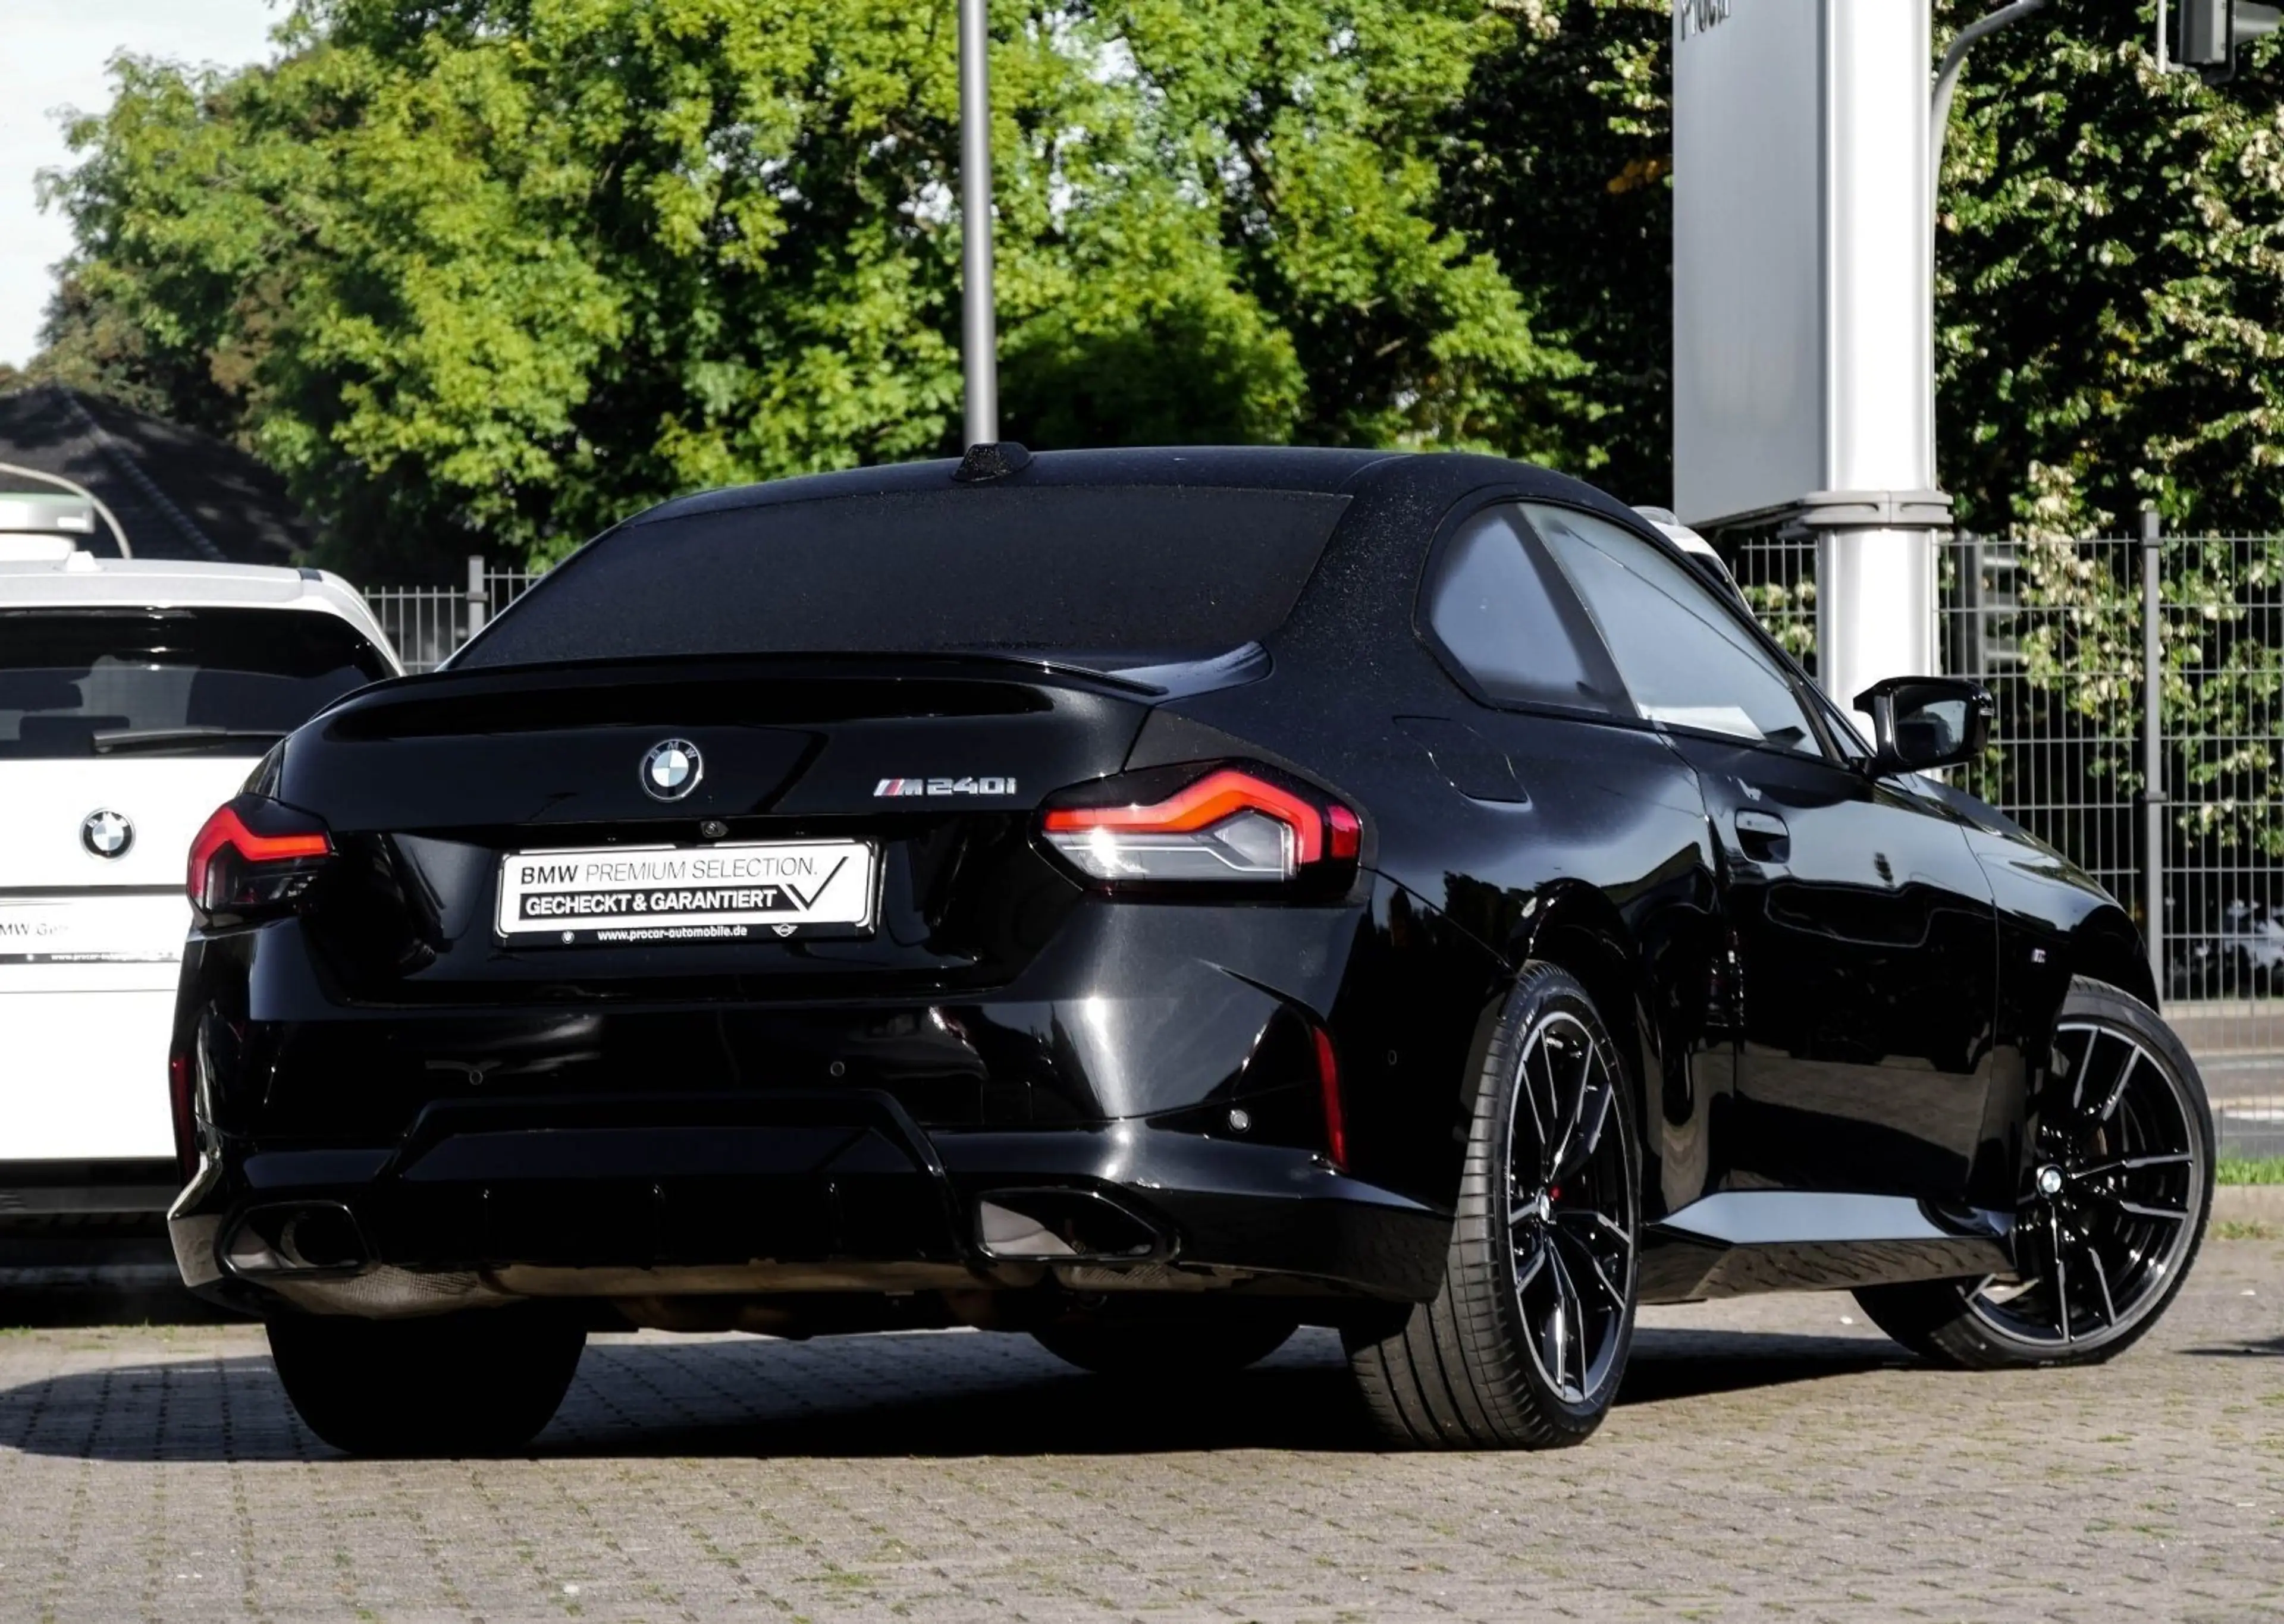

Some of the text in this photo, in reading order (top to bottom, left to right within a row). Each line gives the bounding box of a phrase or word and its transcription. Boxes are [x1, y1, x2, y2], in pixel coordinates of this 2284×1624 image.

[521, 856, 817, 885] BMW PREMIUM SELECTION.
[525, 889, 777, 916] GECHECKT & GARANTIERT
[0, 922, 30, 936] MW
[597, 925, 748, 941] www.procar-automobile.de
